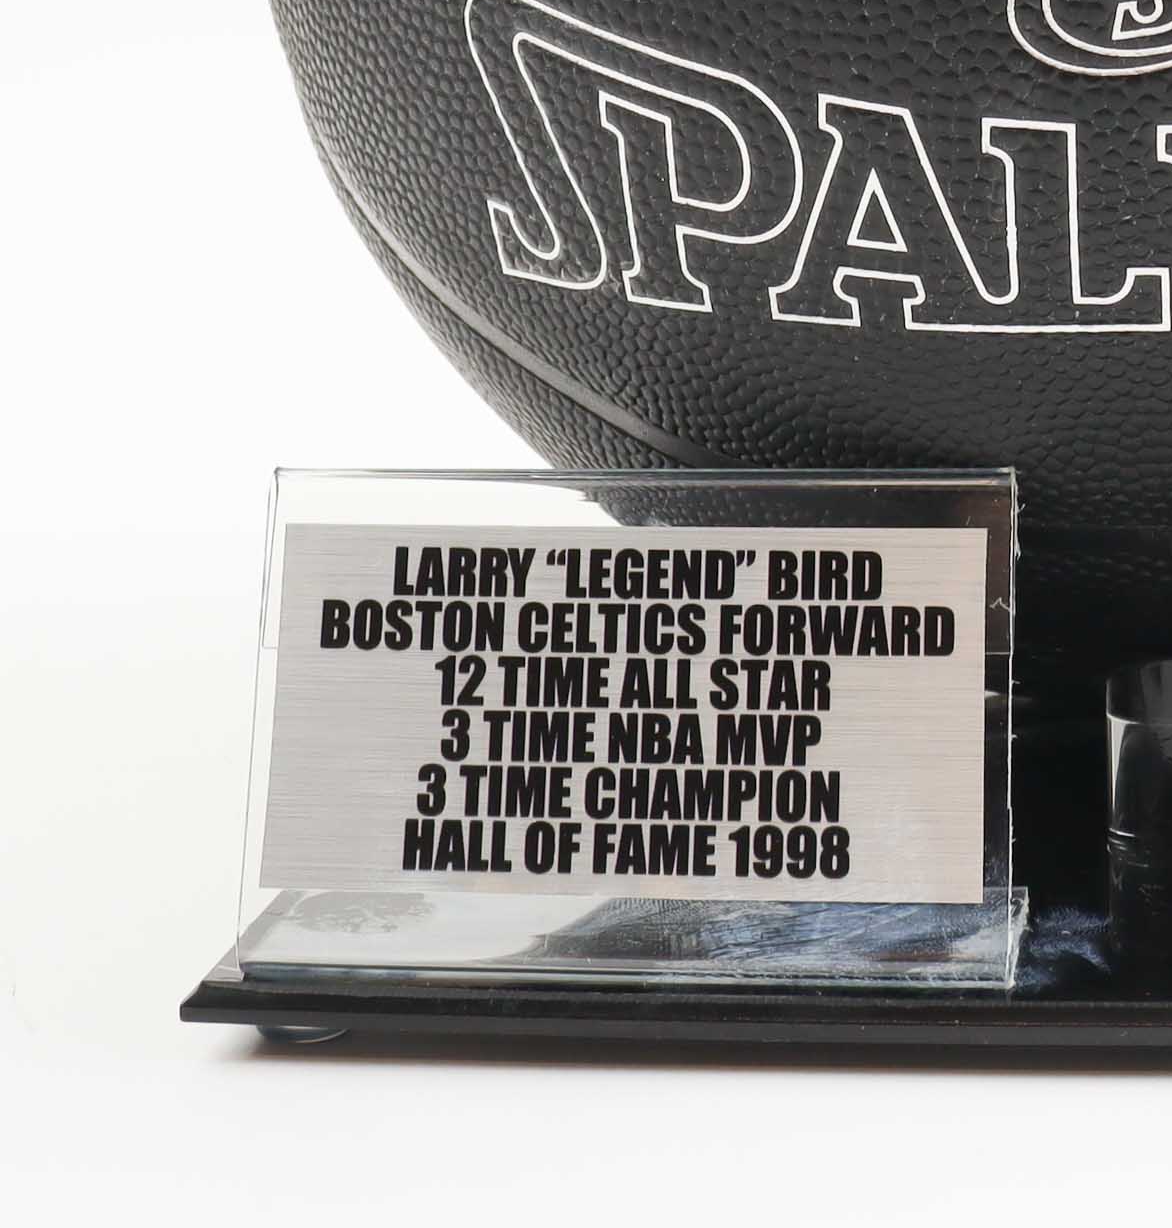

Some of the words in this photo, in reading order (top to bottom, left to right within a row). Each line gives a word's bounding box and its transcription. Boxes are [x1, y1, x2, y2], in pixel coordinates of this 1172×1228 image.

[393, 546, 537, 598] LARRY
[767, 549, 883, 602] BIRD
[319, 599, 506, 653] BOSTON
[517, 601, 707, 656] CELTICS
[719, 603, 955, 657] FORWARD
[434, 654, 487, 707] 12
[497, 655, 610, 709] TIME
[619, 657, 698, 710] ALL
[709, 657, 831, 712] STAR
[440, 708, 471, 762] 3
[482, 710, 596, 763] TIME
[607, 712, 705, 765] NBA
[715, 713, 822, 767] MVP
[416, 763, 447, 817] 3
[459, 764, 573, 819] TIME
[584, 766, 841, 824] CHAMPION
[402, 818, 513, 873] HALL
[524, 820, 582, 875] OF
[592, 822, 717, 877] FAME
[728, 824, 850, 880] 1998
